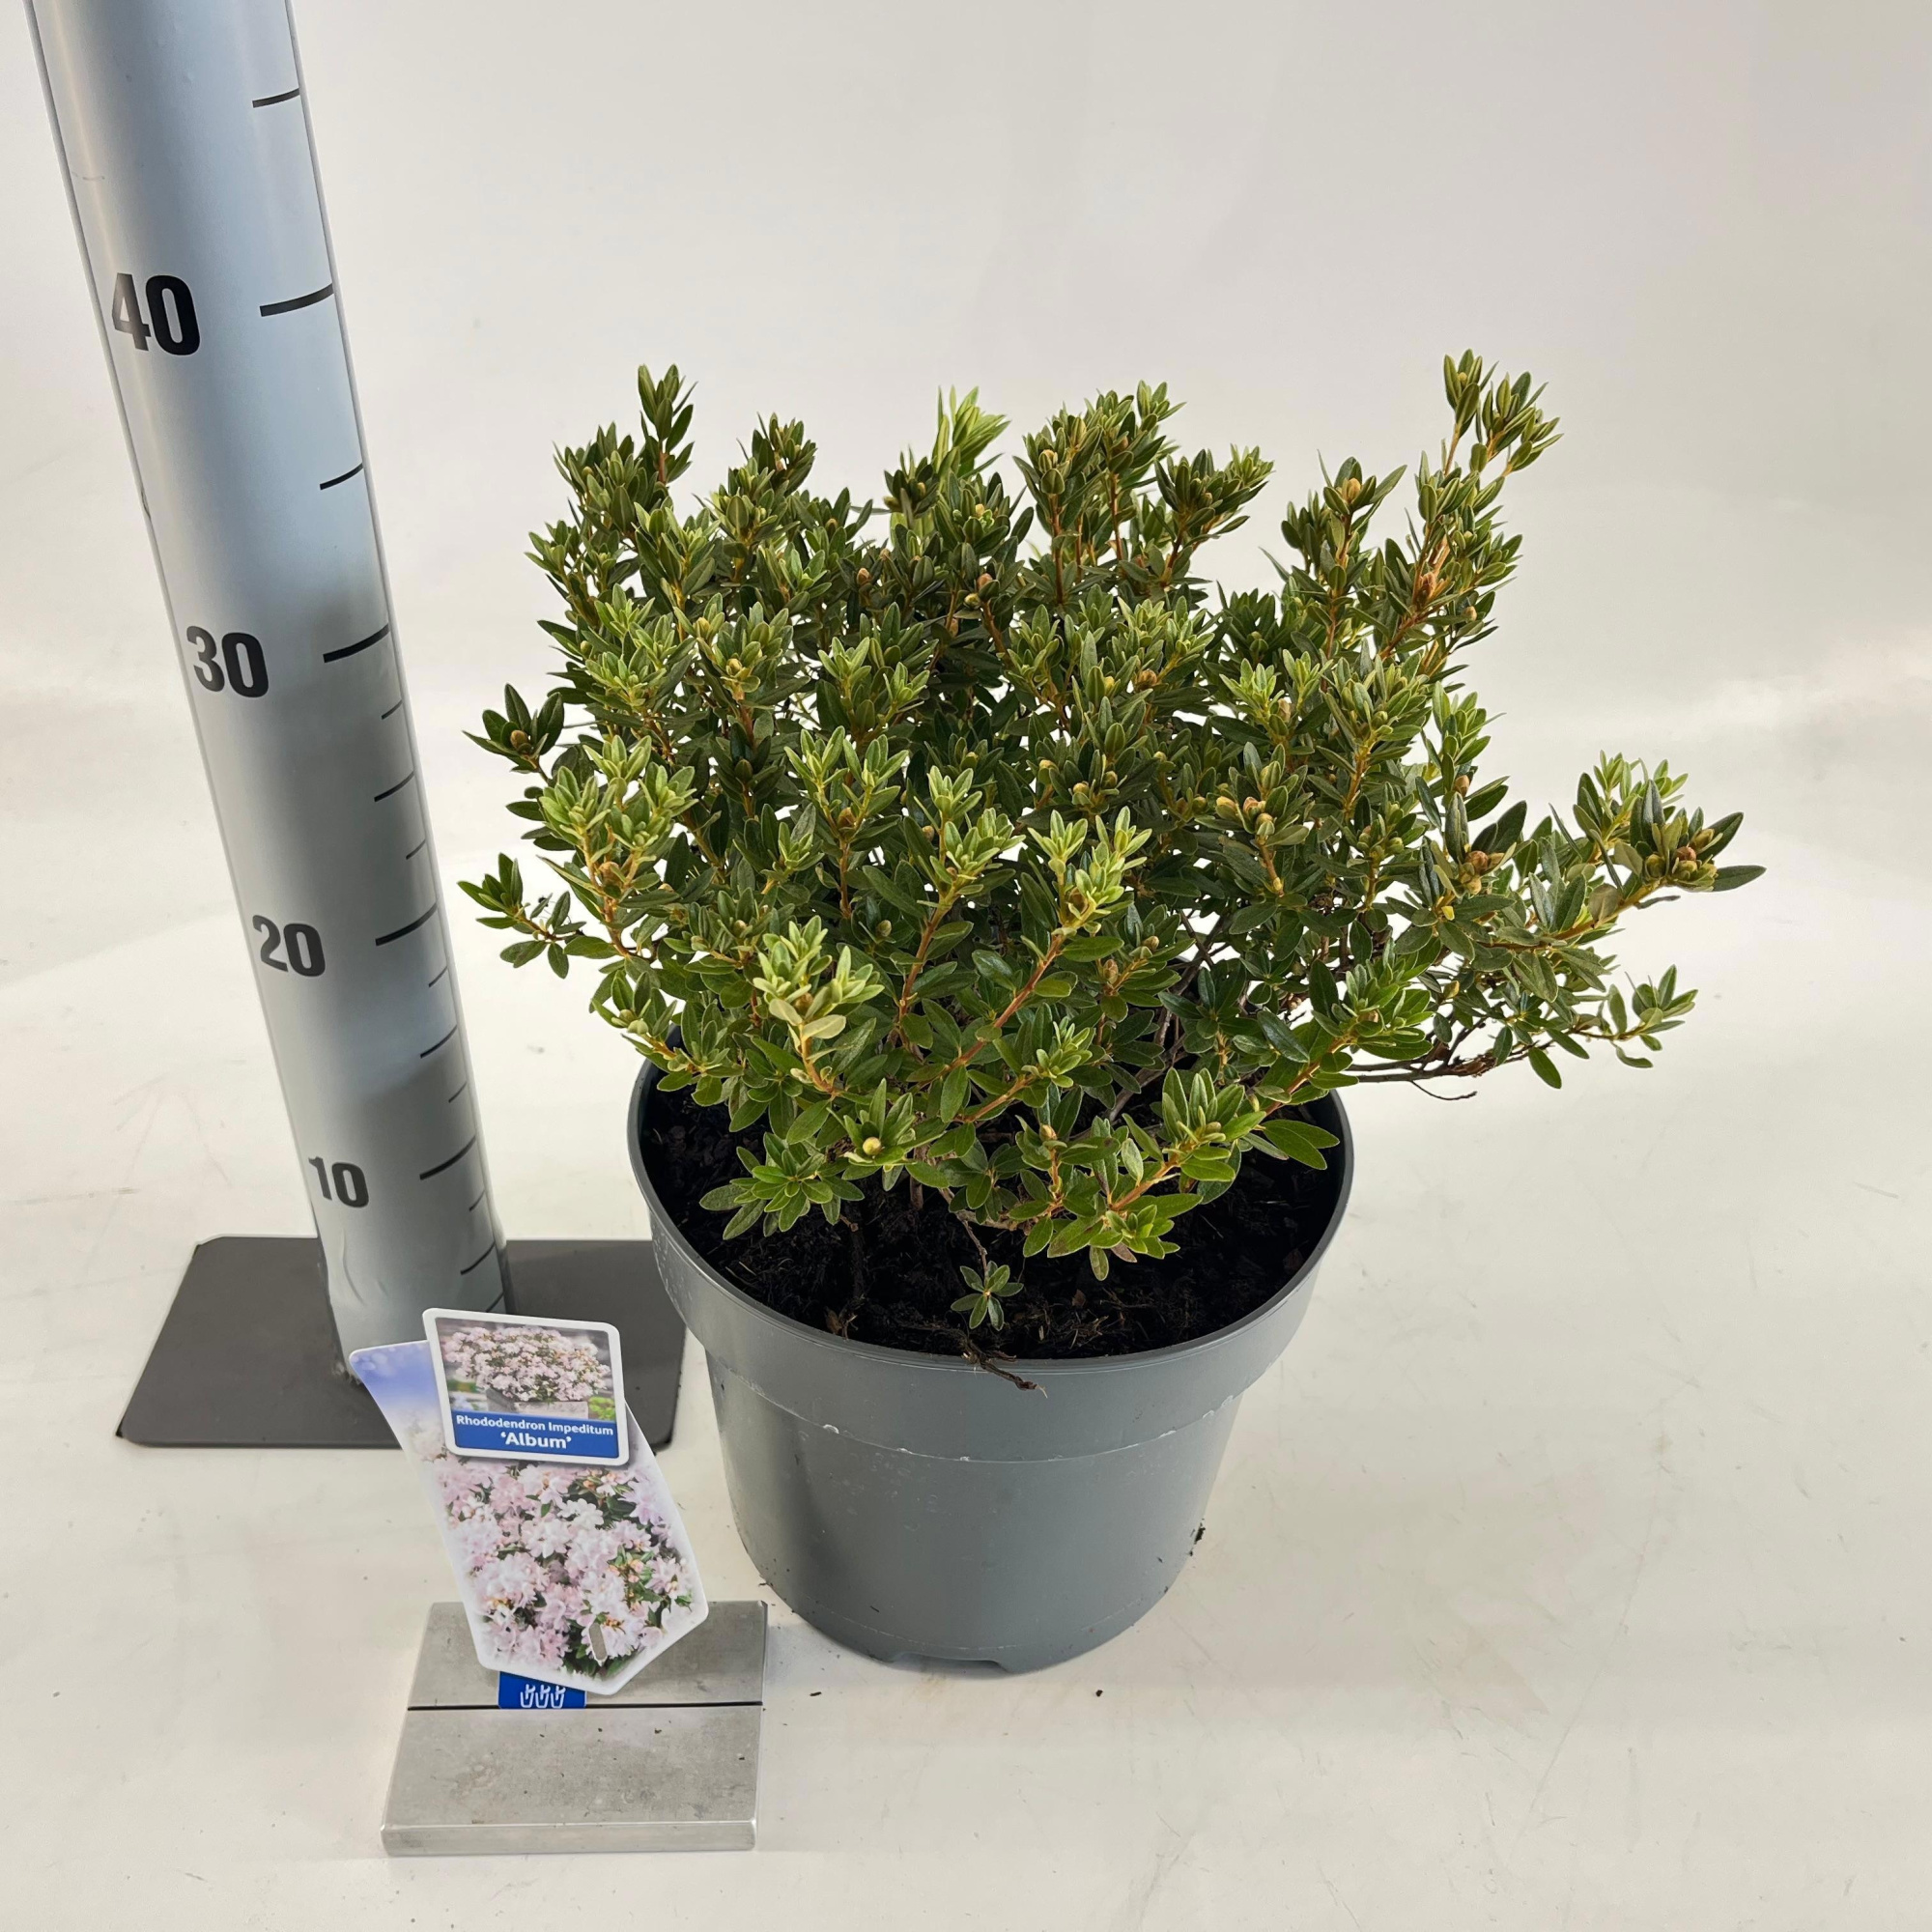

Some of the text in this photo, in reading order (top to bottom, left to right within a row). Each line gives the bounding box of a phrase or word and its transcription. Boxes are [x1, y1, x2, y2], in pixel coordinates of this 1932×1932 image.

[112, 273, 200, 355] 40
[186, 625, 269, 698] 30
[252, 915, 326, 977] 20
[308, 1155, 369, 1208] 10
[456, 1414, 614, 1435] Rhododendron Impeditum
